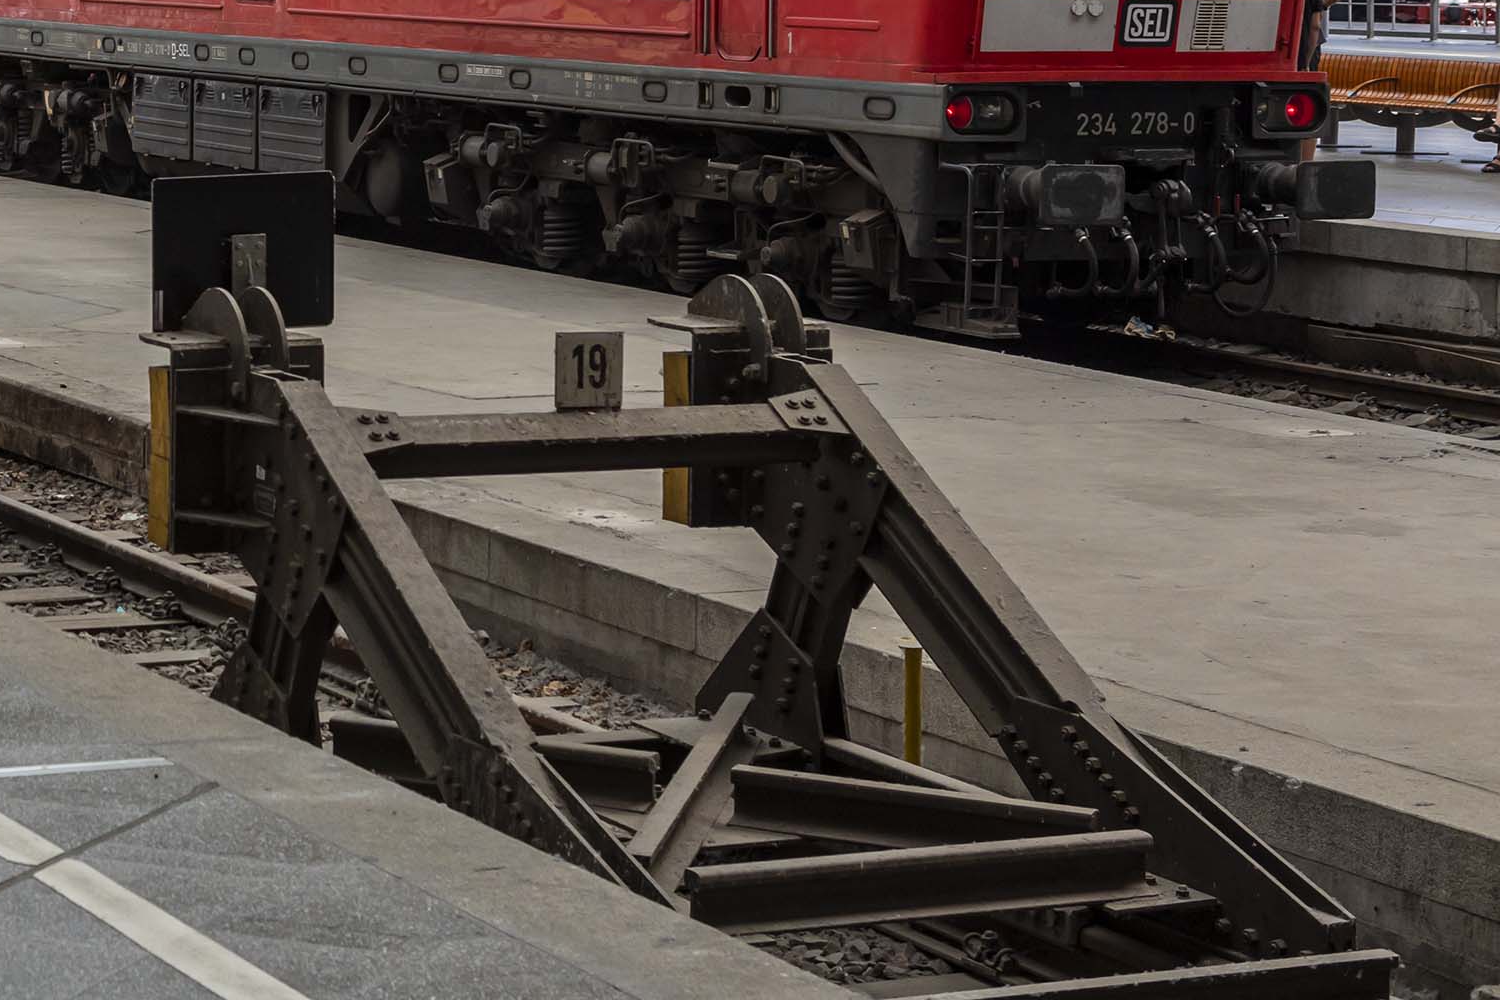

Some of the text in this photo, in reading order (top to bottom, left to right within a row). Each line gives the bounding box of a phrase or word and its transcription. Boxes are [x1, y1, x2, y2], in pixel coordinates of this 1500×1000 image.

[1130, 8, 1166, 38] SEL
[1076, 111, 1195, 136] 234 278-0
[572, 343, 607, 389] 19
